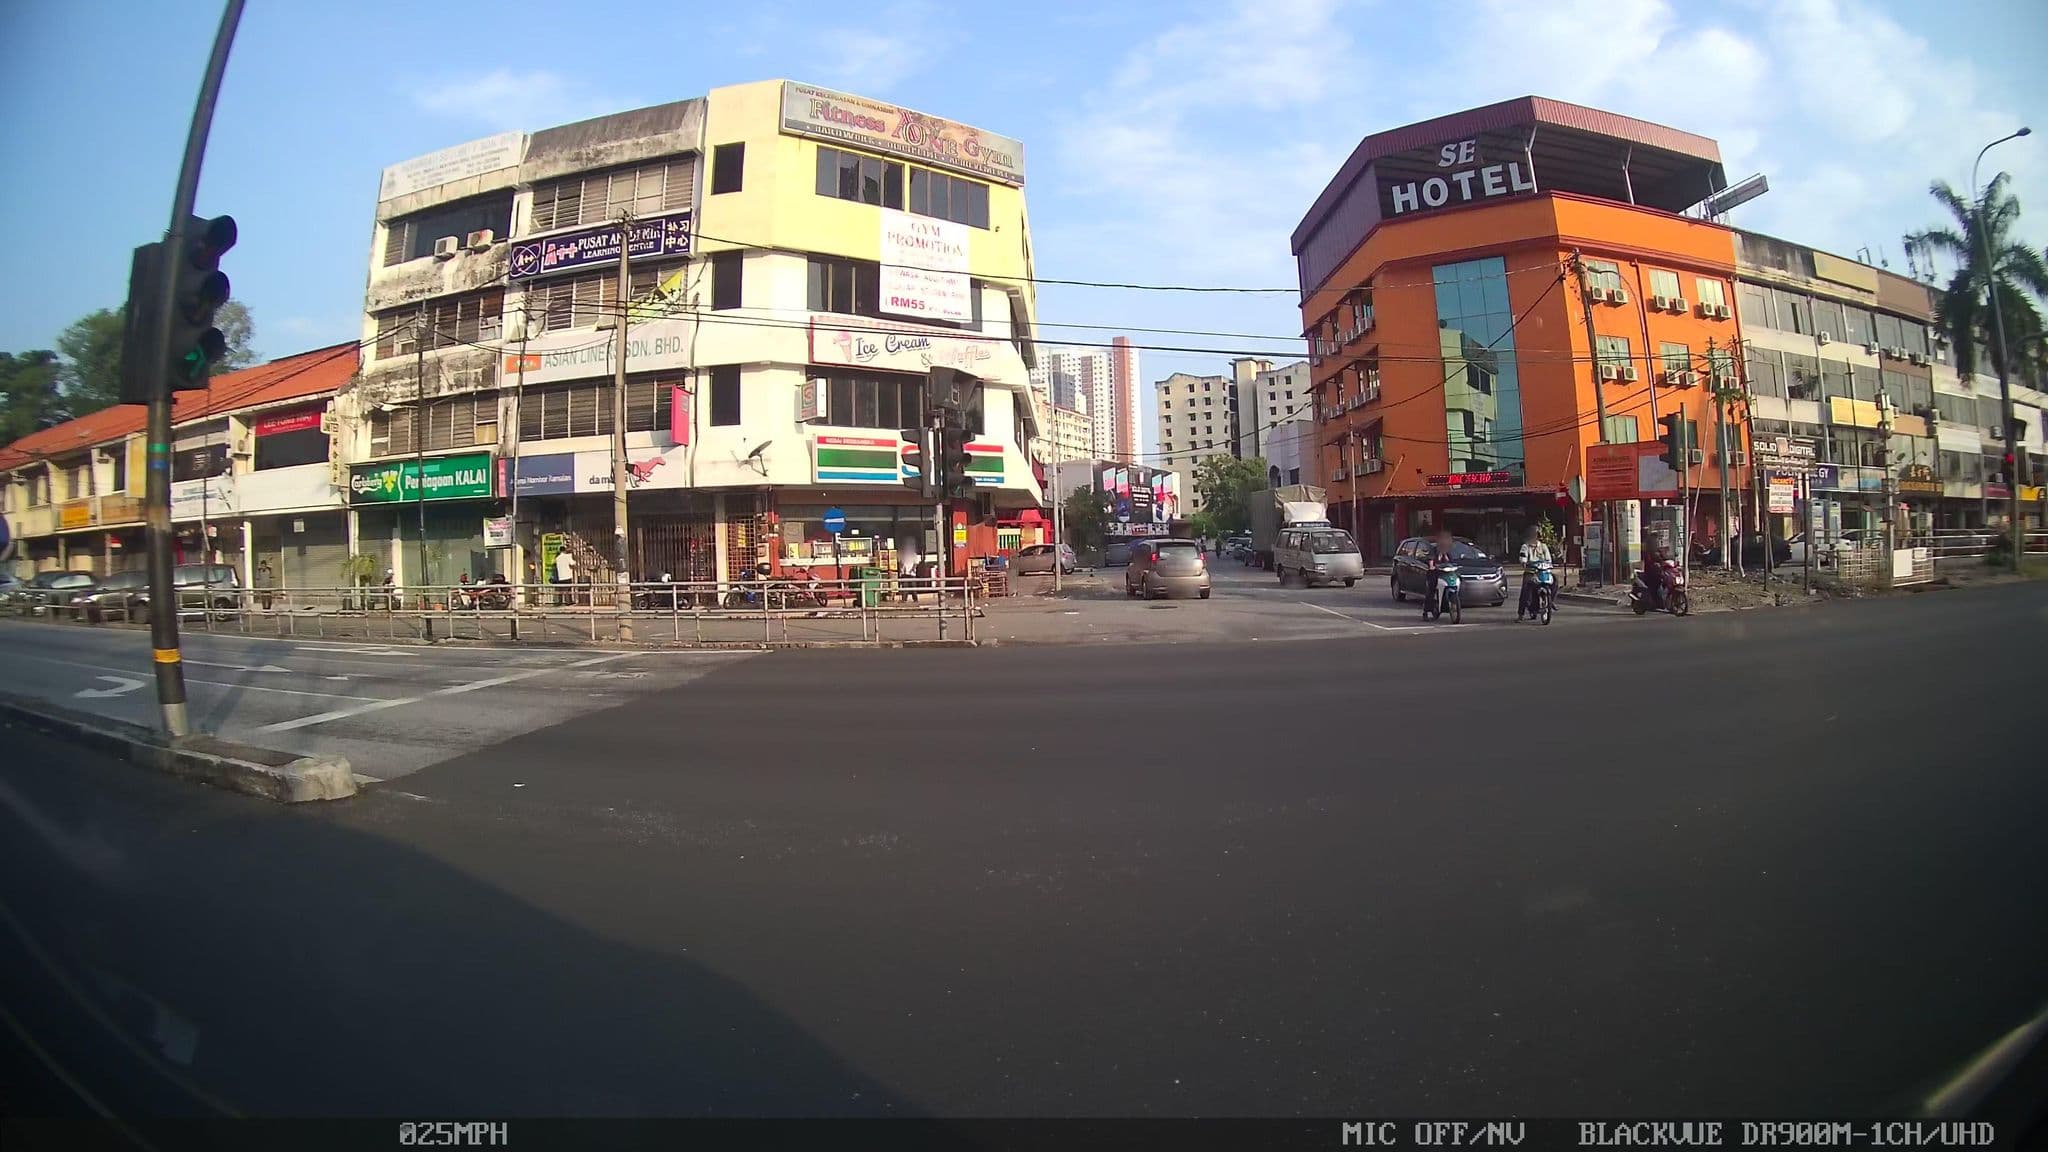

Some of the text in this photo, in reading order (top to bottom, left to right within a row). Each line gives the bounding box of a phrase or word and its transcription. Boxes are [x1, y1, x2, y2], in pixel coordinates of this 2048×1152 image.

[808, 98, 886, 133] Fitness
[1437, 139, 1476, 167] SE
[1391, 162, 1533, 214] HOTEL
[911, 222, 941, 237] GYM
[578, 234, 609, 251] PUSAT
[582, 245, 621, 260] LEARNING
[887, 231, 963, 257] PROMOTION
[544, 242, 578, 266] A++
[890, 296, 926, 310] RM55
[544, 350, 577, 368] ASIAN
[625, 340, 652, 358] SDN.
[654, 335, 684, 355] BHD.
[855, 334, 930, 357] Ice Cream
[1753, 441, 1816, 457] SOLID DIGITAL
[455, 468, 487, 487] KALAI
[589, 474, 600, 485] da
